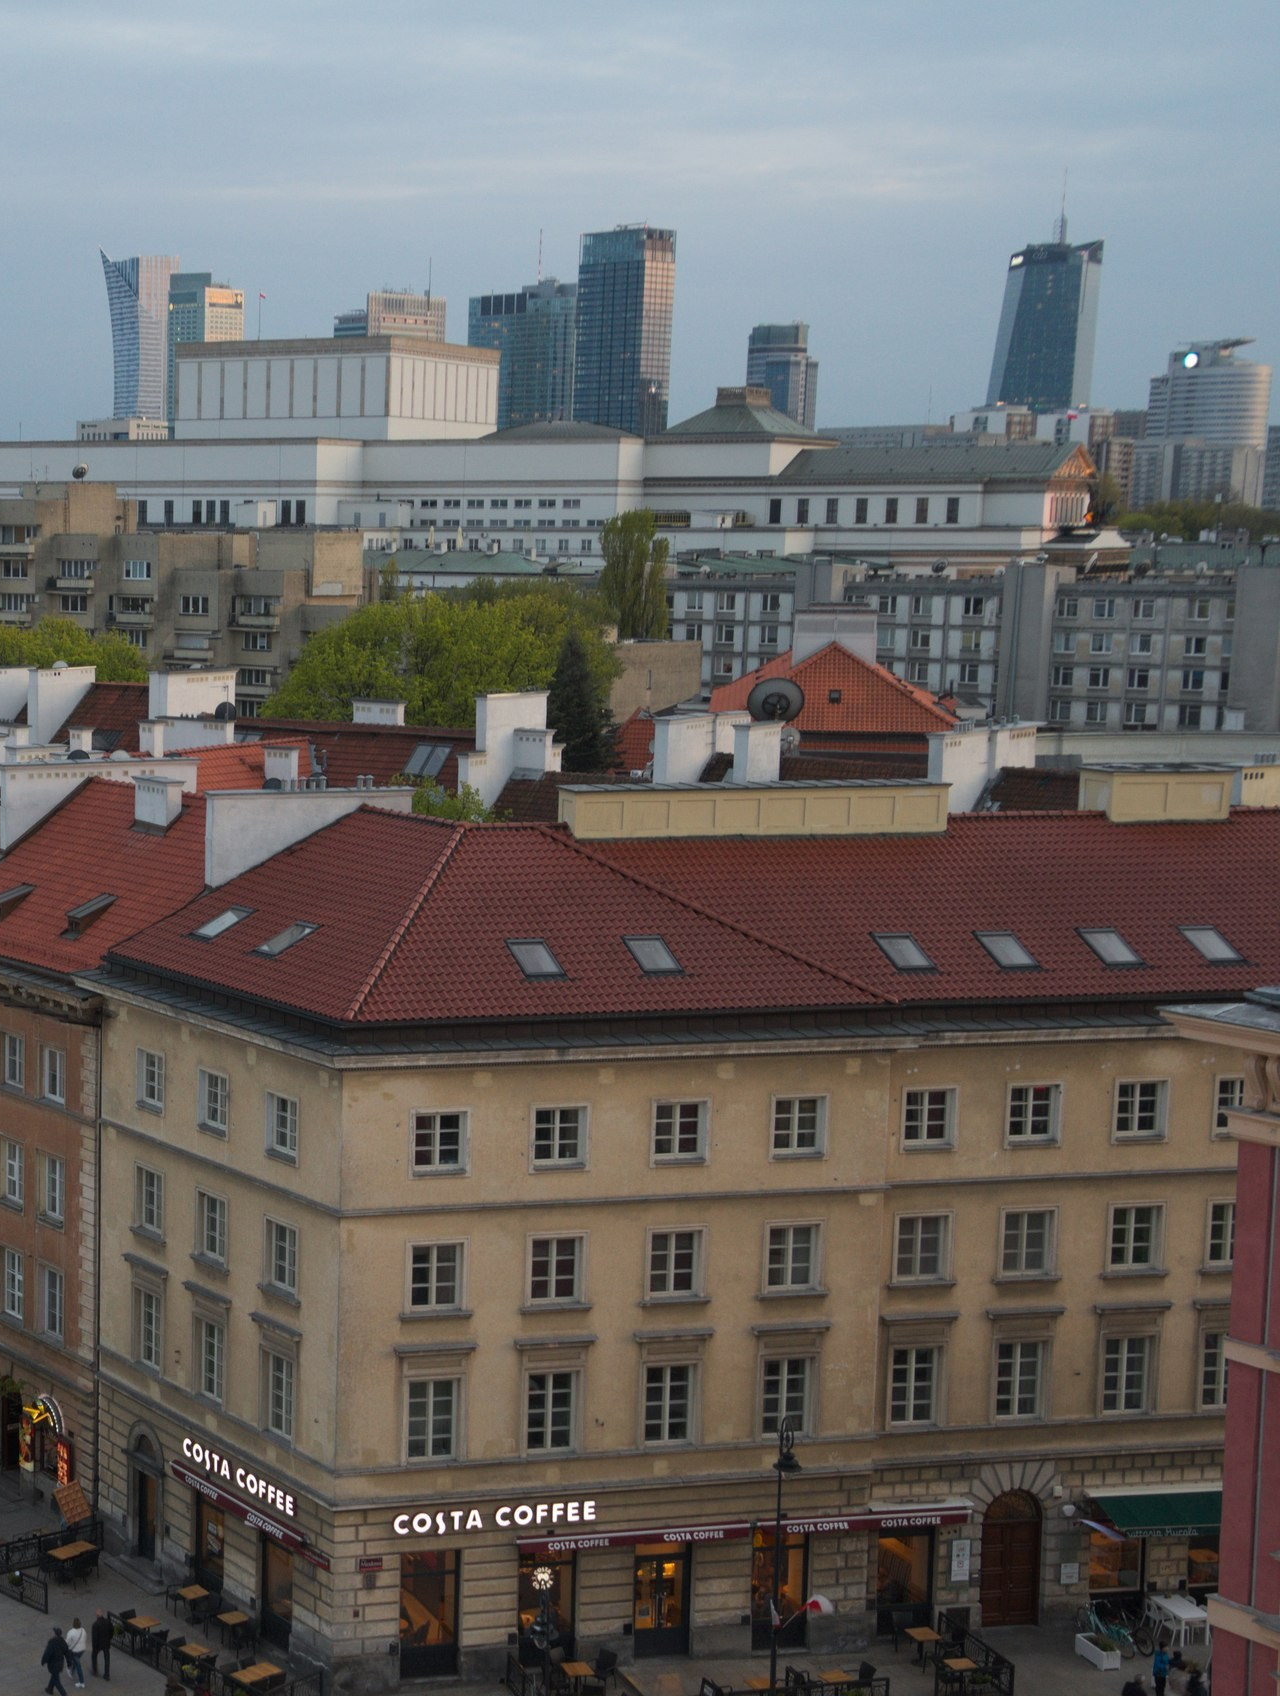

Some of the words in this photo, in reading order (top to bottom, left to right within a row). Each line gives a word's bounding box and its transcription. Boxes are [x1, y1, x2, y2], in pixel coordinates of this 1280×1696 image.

[182, 1437, 231, 1480] COSTA
[236, 1467, 295, 1517] COFFEE
[184, 1475, 200, 1490] COSTA
[200, 1485, 218, 1501] COFFEE
[246, 1512, 263, 1529] COSTA
[263, 1522, 284, 1540] COFFEE
[393, 1509, 483, 1535] COSTA
[495, 1500, 596, 1527] COFFEE
[786, 1523, 815, 1533] COSTA
[817, 1521, 849, 1531] COFFEE
[881, 1518, 908, 1528] COSTA
[910, 1516, 941, 1526] COFFEE
[548, 1541, 576, 1551] COSTA
[577, 1538, 609, 1549] COFFEE
[663, 1532, 692, 1542] COSTA
[693, 1530, 724, 1540] COFFEE
